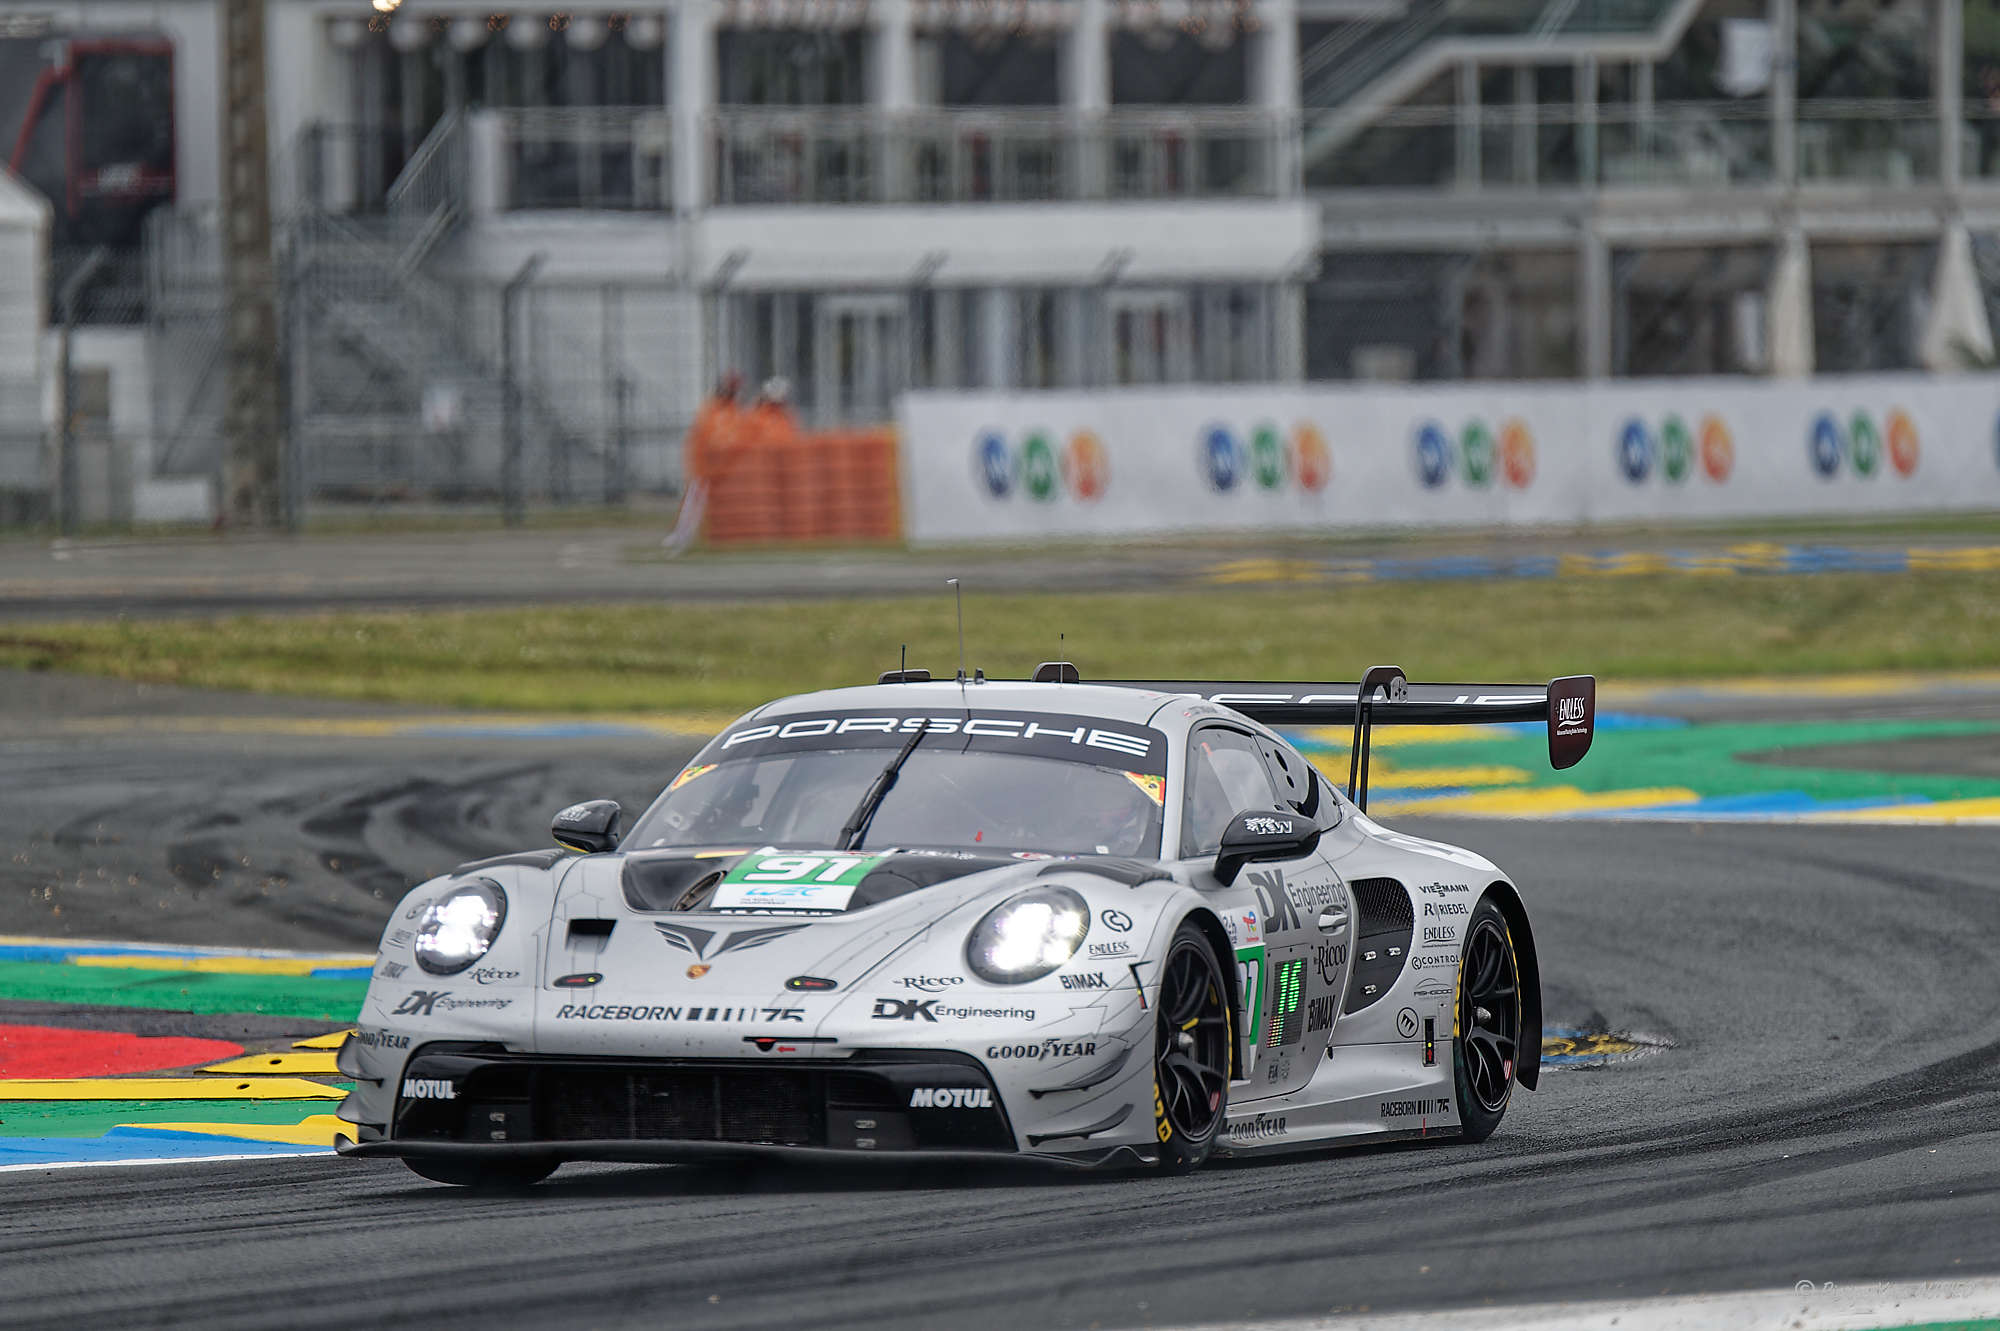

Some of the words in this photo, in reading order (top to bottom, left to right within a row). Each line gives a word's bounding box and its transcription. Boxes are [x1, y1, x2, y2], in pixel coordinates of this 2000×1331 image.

[1559, 697, 1585, 721] ENDLESS
[721, 717, 1151, 757] PORSCHE
[743, 856, 862, 882] 91
[1419, 882, 1470, 898] VIESSMANN
[1246, 869, 1301, 934] DK
[1287, 877, 1348, 914] Engineering
[1439, 903, 1469, 915] RIEDEL
[1424, 927, 1456, 941] ENDLESS
[1088, 941, 1130, 956] ENDLESS
[1422, 954, 1459, 964] CONTROL
[1318, 939, 1347, 985] Ricco
[902, 975, 964, 992] Ricco
[390, 990, 454, 1016] DK
[1239, 961, 1259, 1037] 1
[556, 1004, 682, 1021] RACEBORN
[871, 998, 938, 1022] DK
[934, 1005, 1036, 1022] Engineering
[986, 1039, 1096, 1060] GOODYEAR
[403, 1078, 456, 1100] MOTUL
[910, 1088, 994, 1108] MOTUL
[1381, 1101, 1417, 1118] RACEBORN
